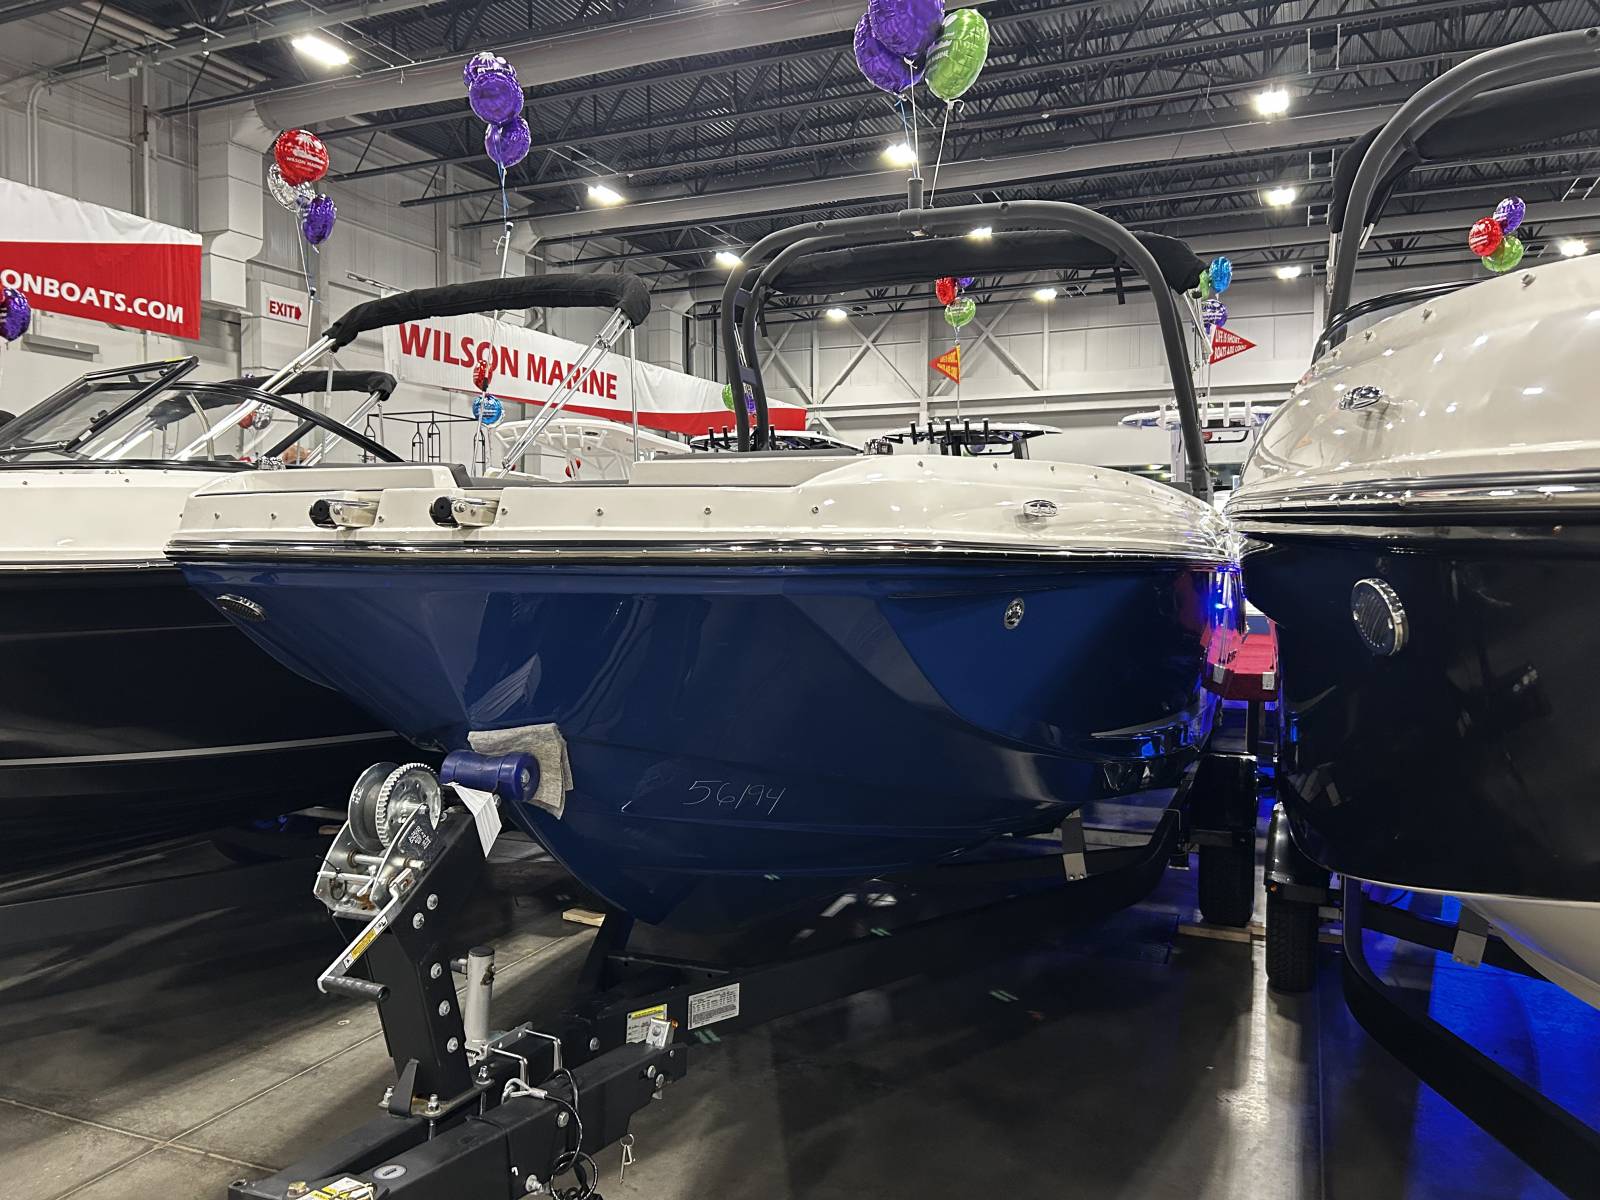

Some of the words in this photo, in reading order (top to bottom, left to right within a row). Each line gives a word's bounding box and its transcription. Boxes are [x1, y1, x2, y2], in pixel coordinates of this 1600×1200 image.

[0, 269, 184, 324] ONBOATS.COM
[269, 300, 294, 318] EXIT
[399, 323, 519, 378] WILSON
[526, 352, 618, 400] MARINE
